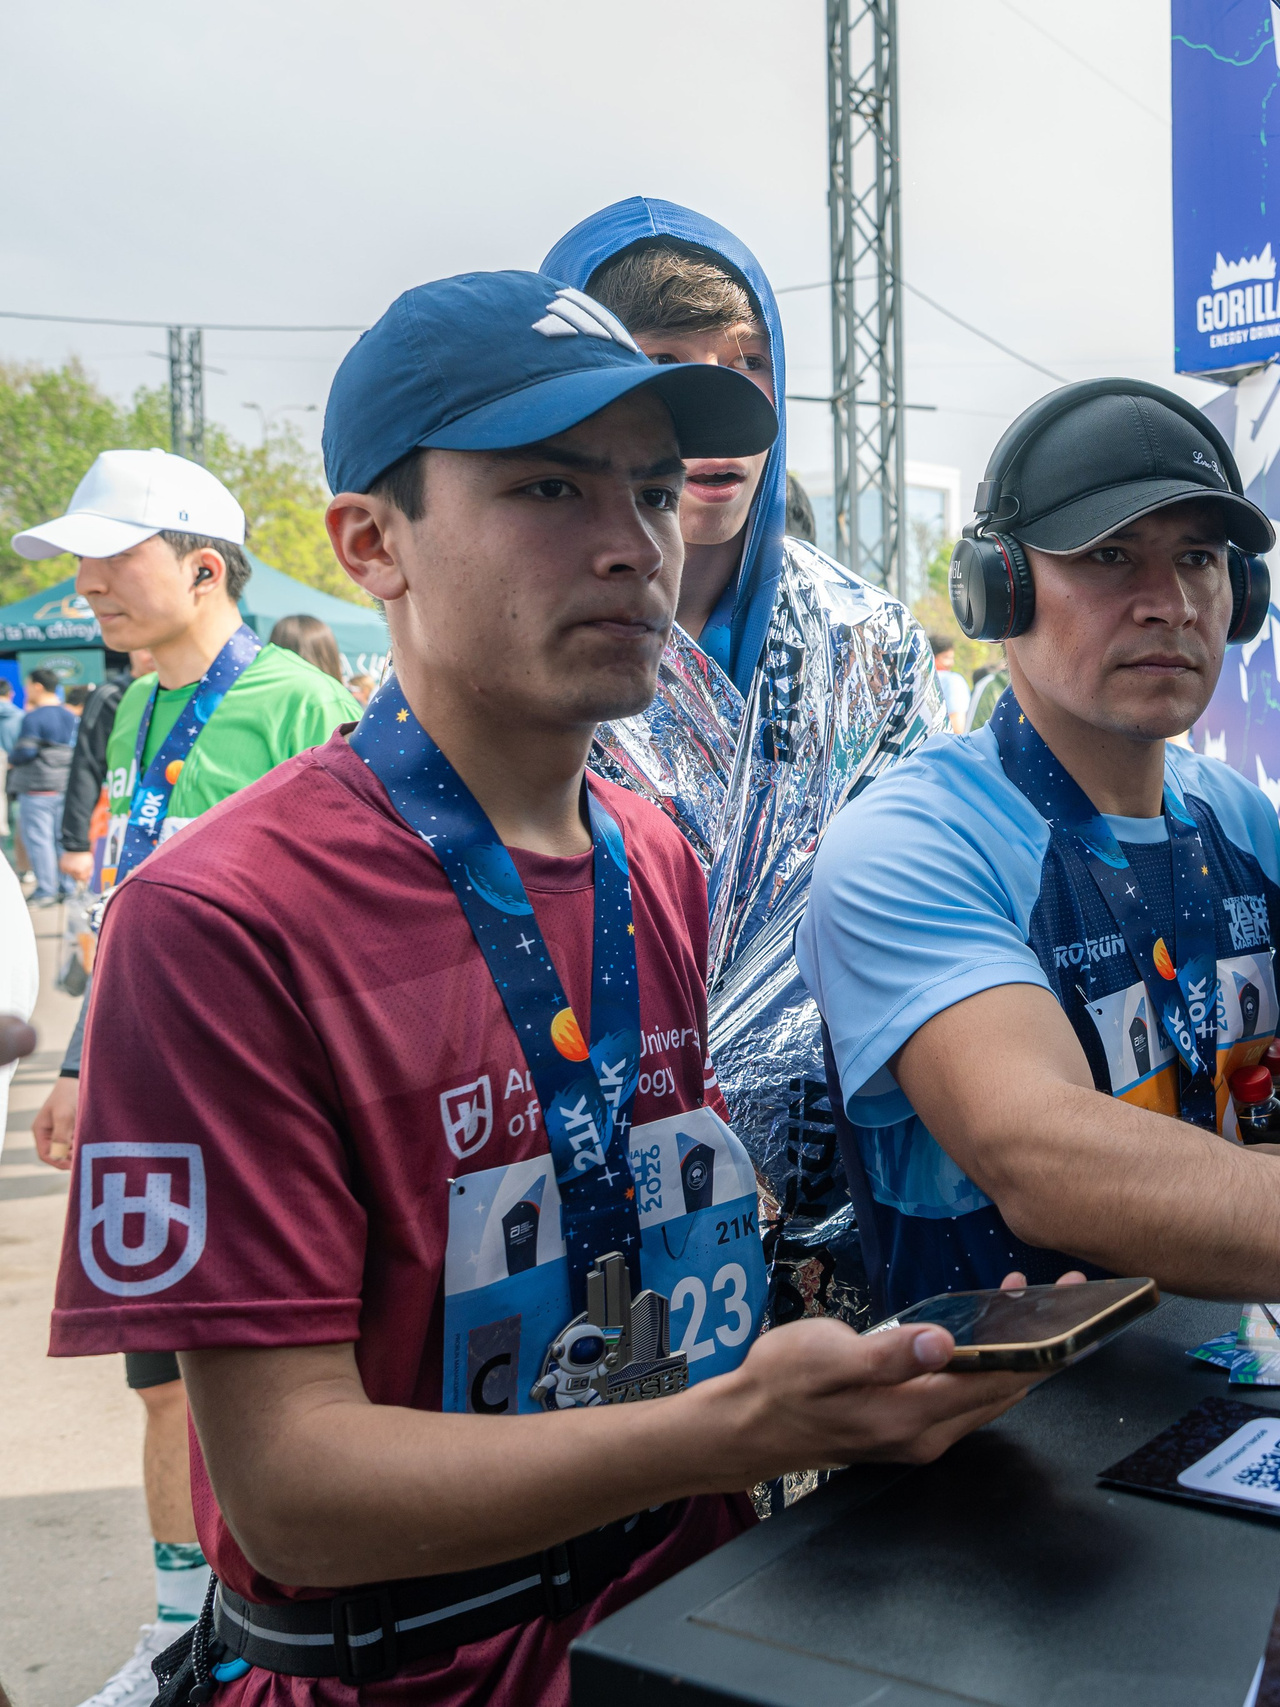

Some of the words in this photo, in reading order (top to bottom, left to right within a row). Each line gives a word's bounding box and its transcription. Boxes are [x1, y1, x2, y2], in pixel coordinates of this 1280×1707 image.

[1209, 329, 1249, 348] ENERGY
[949, 560, 962, 579] BL
[138, 791, 165, 828] 10K
[1053, 942, 1085, 969] RO
[508, 1099, 540, 1137] of
[559, 1095, 606, 1171] 21K
[715, 1211, 757, 1246] 21K
[471, 1352, 512, 1413] C
